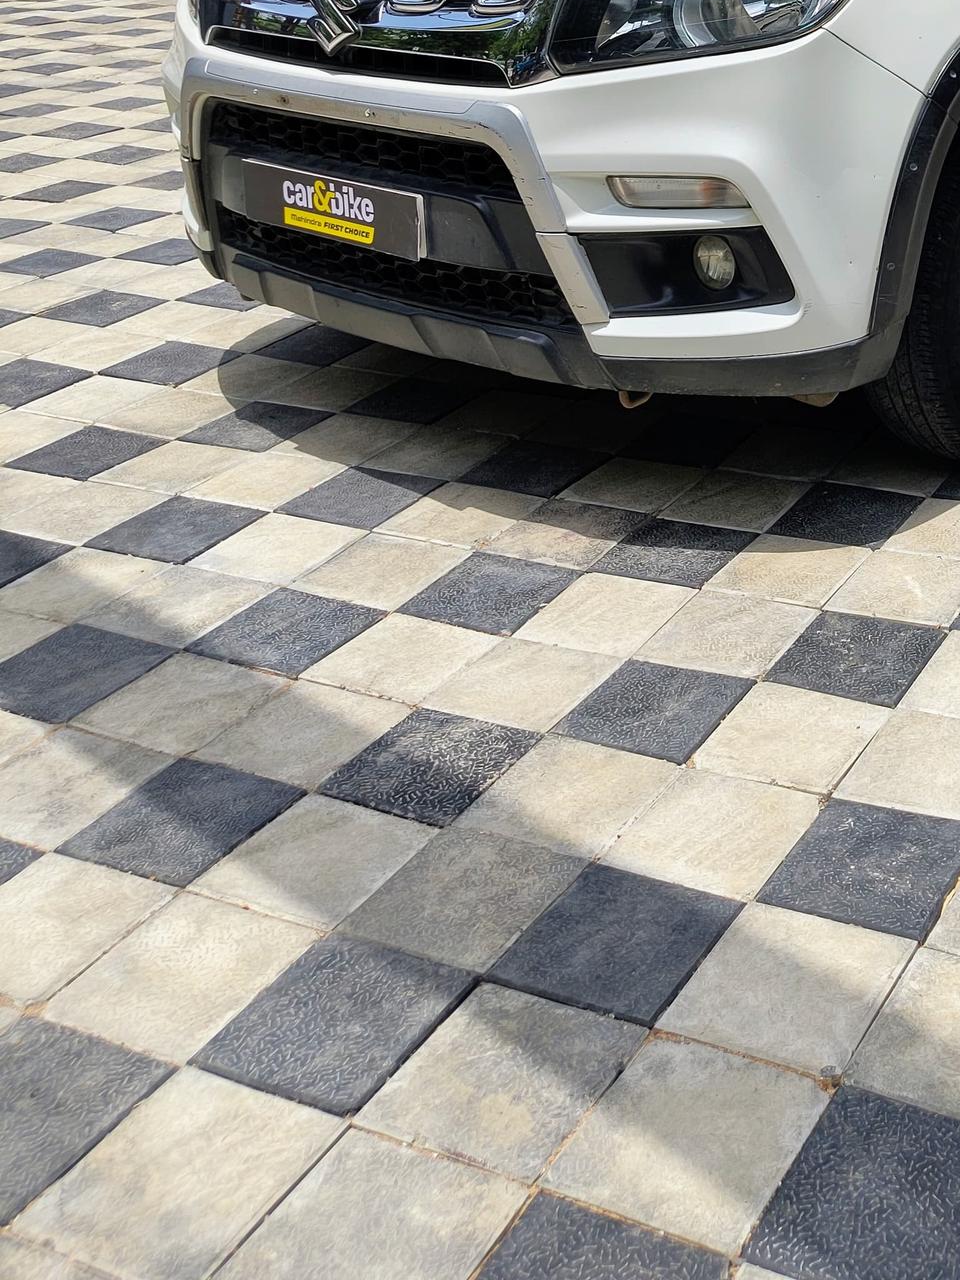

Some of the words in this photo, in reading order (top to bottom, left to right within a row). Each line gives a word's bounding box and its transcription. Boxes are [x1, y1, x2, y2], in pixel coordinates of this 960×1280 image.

[282, 180, 375, 223] car&bike
[323, 221, 344, 232] FIRST
[344, 226, 370, 239] CHOICE
